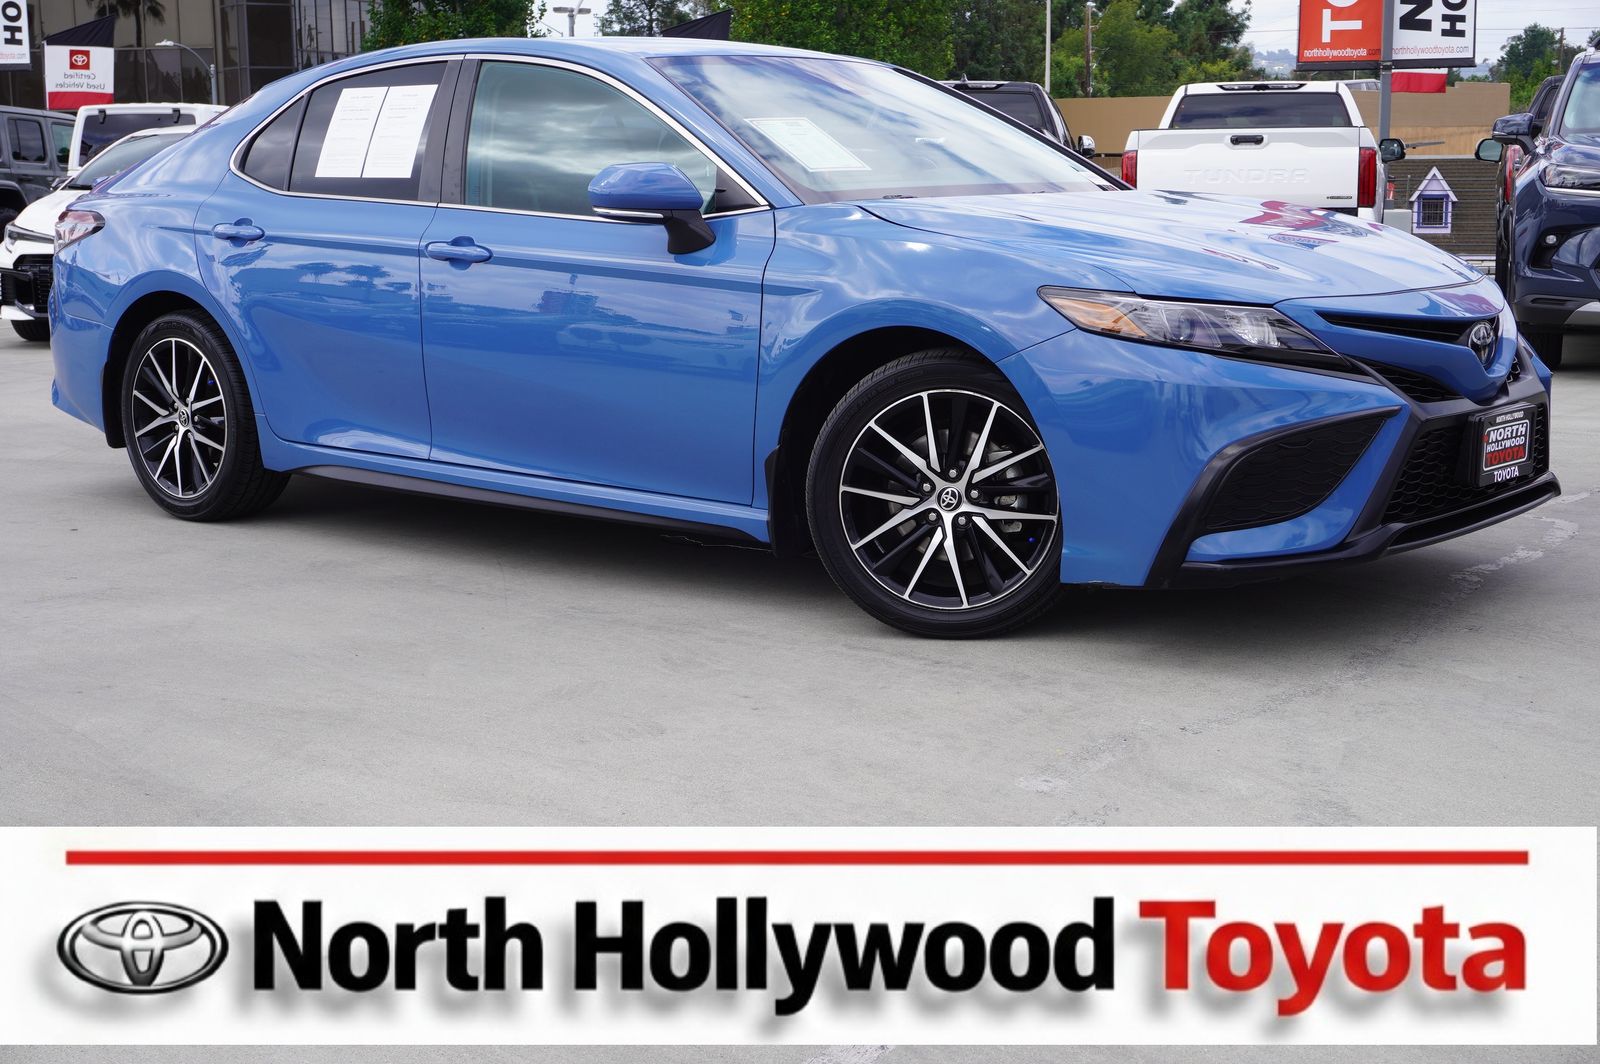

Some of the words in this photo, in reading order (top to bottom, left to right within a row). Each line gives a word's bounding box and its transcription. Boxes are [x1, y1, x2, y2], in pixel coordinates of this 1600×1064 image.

[1184, 168, 1311, 185] TUNDRA
[1488, 423, 1527, 443] NORTH
[1486, 436, 1525, 453] HOLLYWOOD
[1486, 446, 1525, 466] TOYOTA
[1494, 466, 1519, 482] TOYOTA
